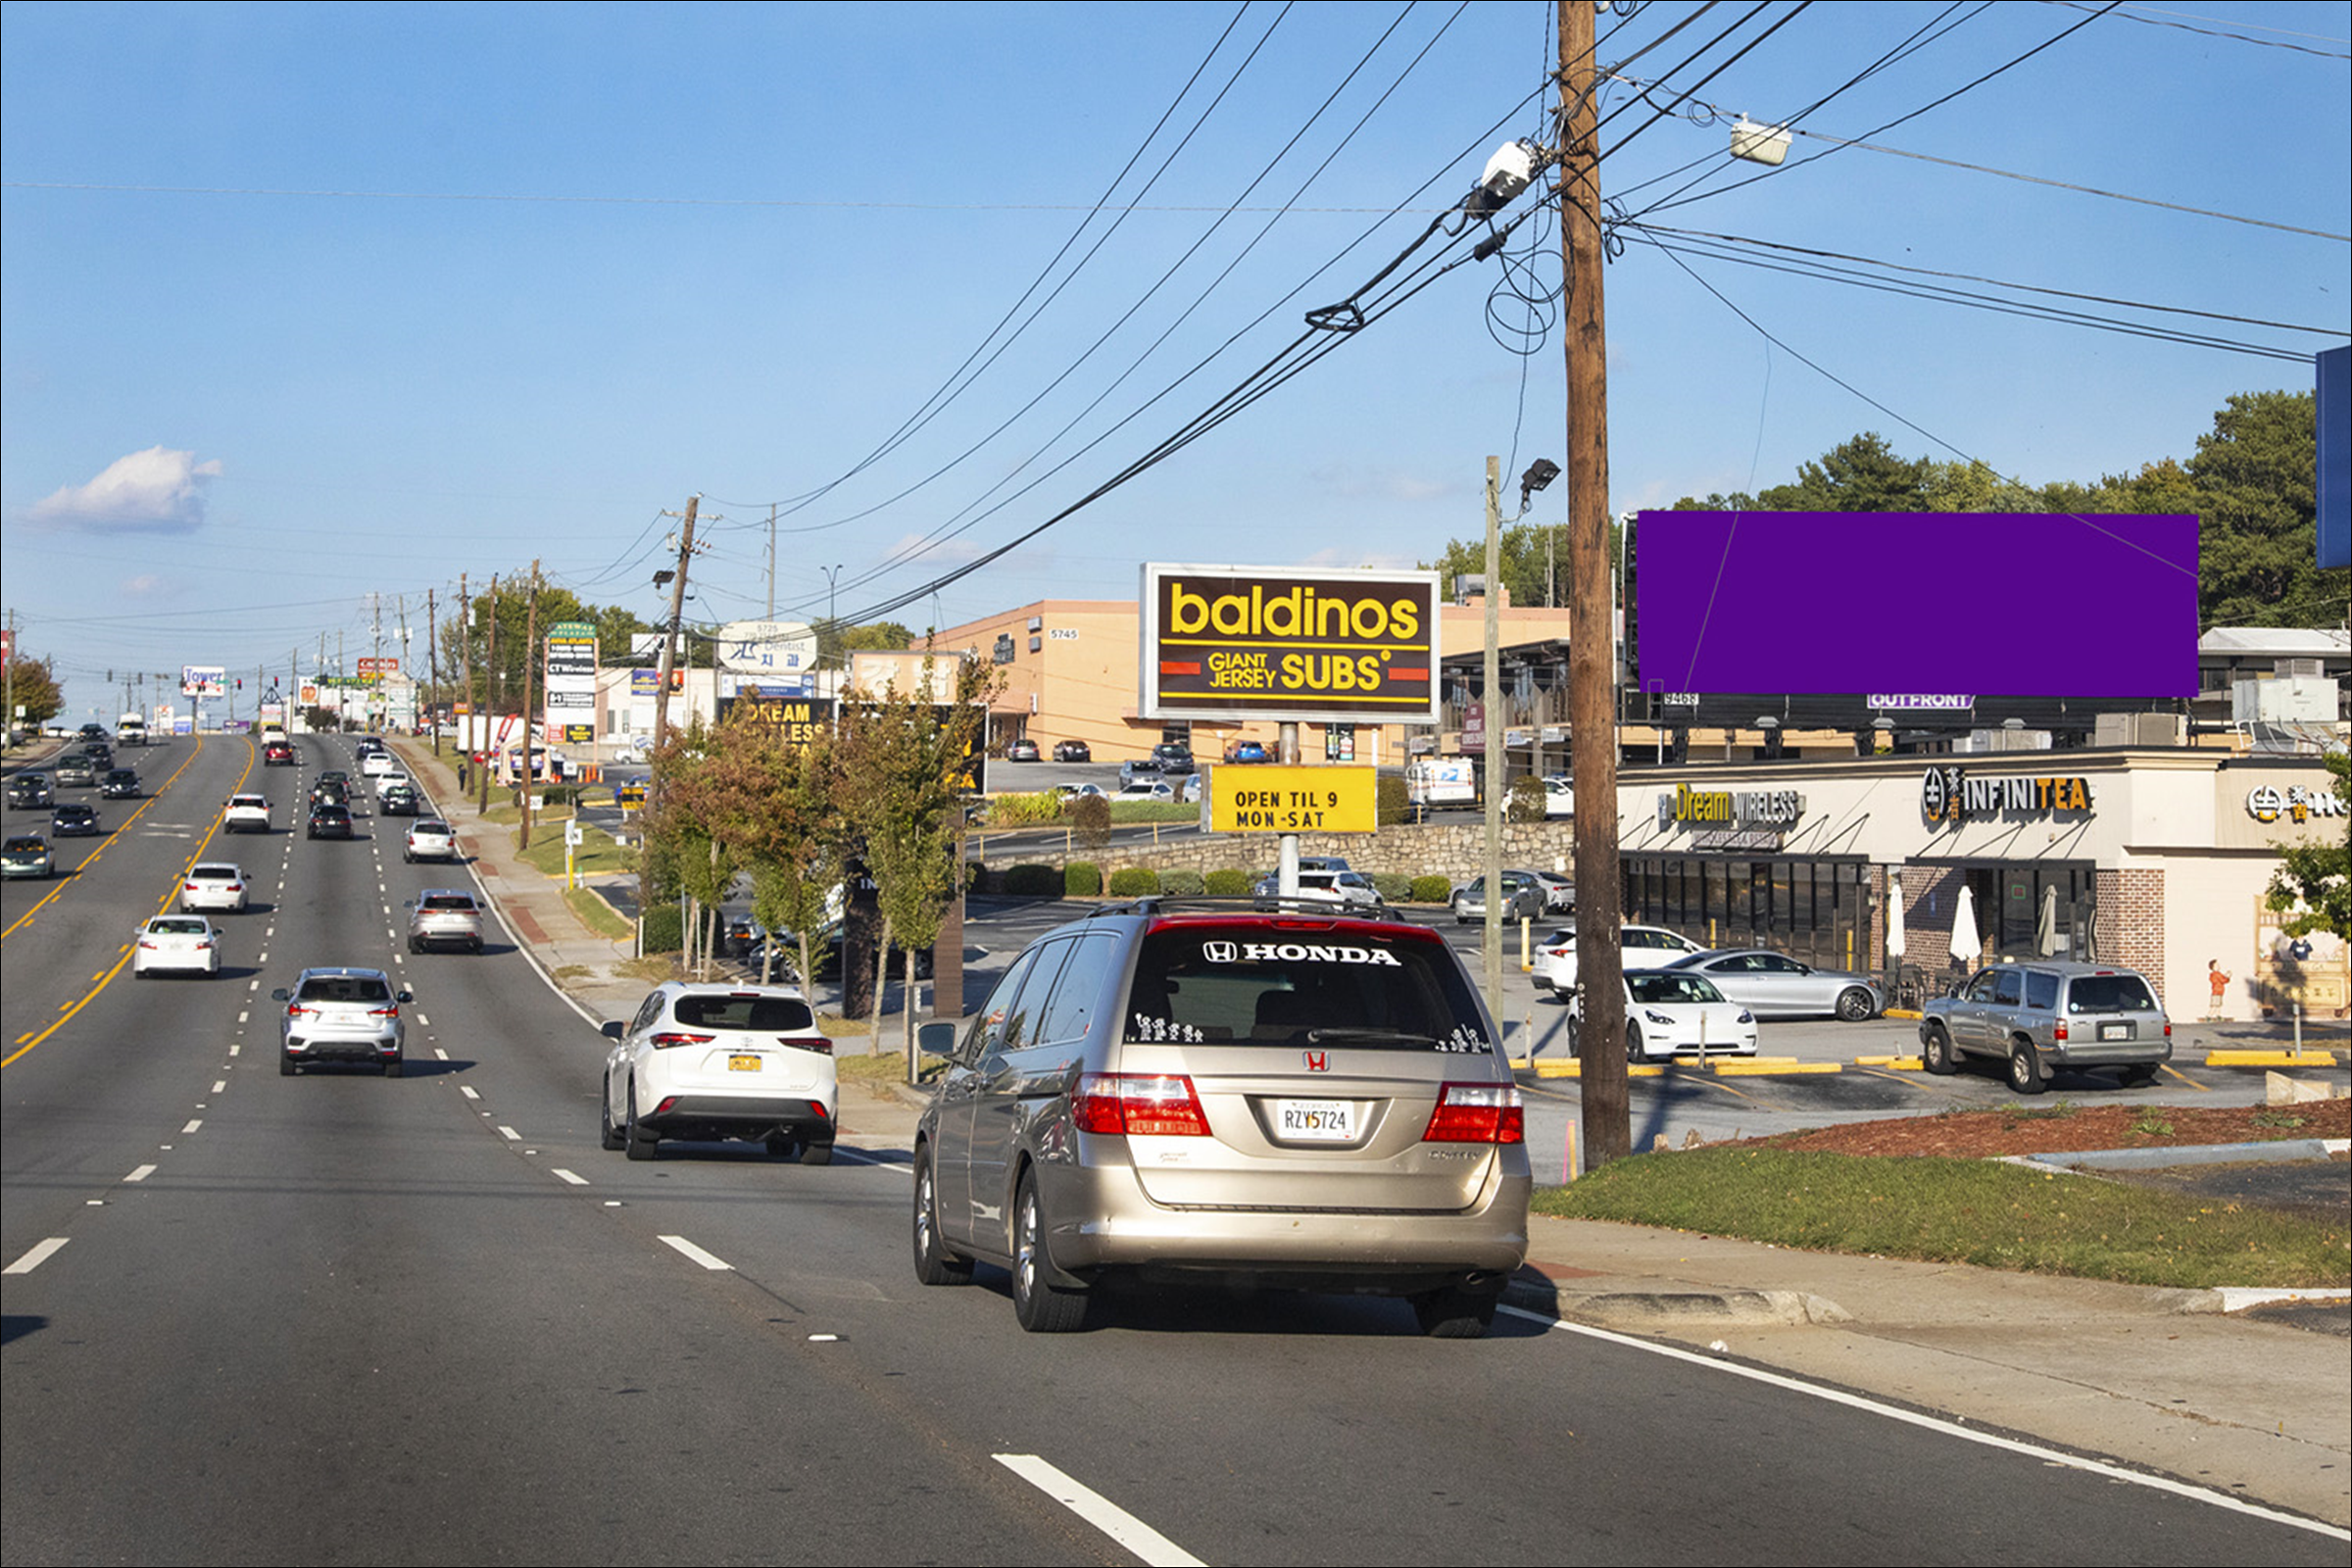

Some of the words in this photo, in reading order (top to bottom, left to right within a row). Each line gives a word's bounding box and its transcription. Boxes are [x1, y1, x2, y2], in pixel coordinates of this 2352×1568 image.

[1171, 582, 1419, 640] baldinos
[1051, 629, 1078, 639] 5745
[764, 640, 806, 652] Dentist
[185, 668, 223, 683] Tower
[1208, 652, 1268, 671] GIANT
[1280, 654, 1381, 691] SUBS
[1208, 669, 1277, 689] JERSEY
[1665, 693, 1696, 705] 9468
[1871, 694, 1971, 707] OUTFRONT
[747, 703, 810, 723] DREAM
[1235, 791, 1280, 808] OPEN
[1289, 792, 1318, 808] TIL
[1327, 791, 1338, 808] 9
[1676, 782, 1730, 821] Dream
[1735, 790, 1797, 821] WIRELESS
[1962, 777, 2087, 810] INFINITEA
[1243, 944, 1402, 966] HONDA
[1285, 1109, 1347, 1131] RZY5724
